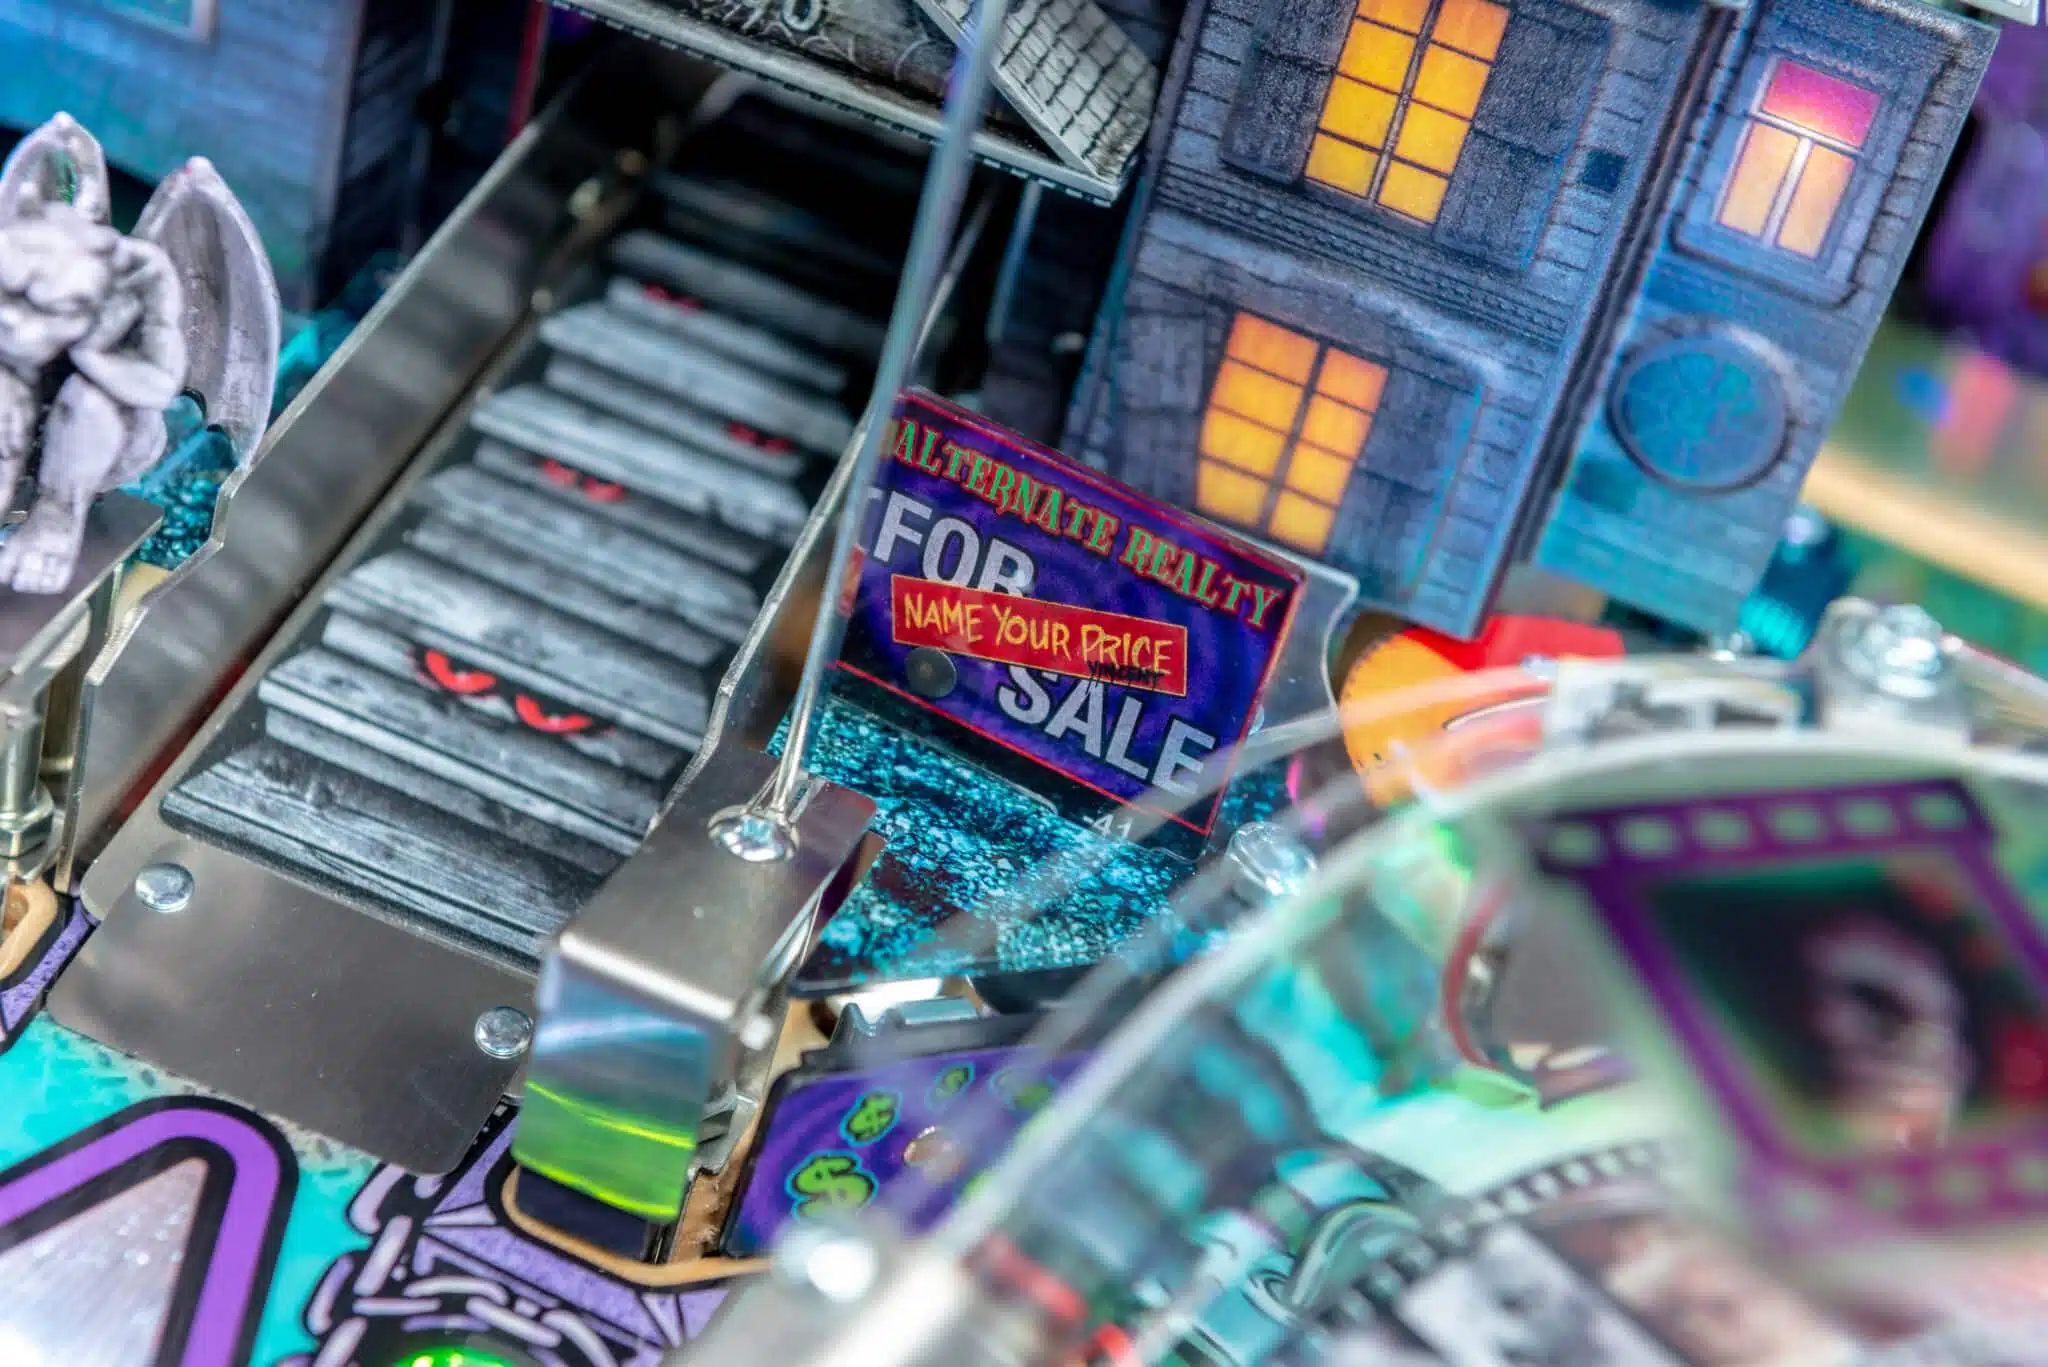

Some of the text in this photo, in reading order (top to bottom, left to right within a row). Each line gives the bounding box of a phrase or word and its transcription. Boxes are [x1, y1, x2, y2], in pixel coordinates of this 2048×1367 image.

[873, 490, 1035, 598] FOR
[894, 418, 1281, 629] ALTERNATE REALTY
[904, 592, 1174, 676] NAME YOUR PRICE
[998, 664, 1216, 797] SALE
